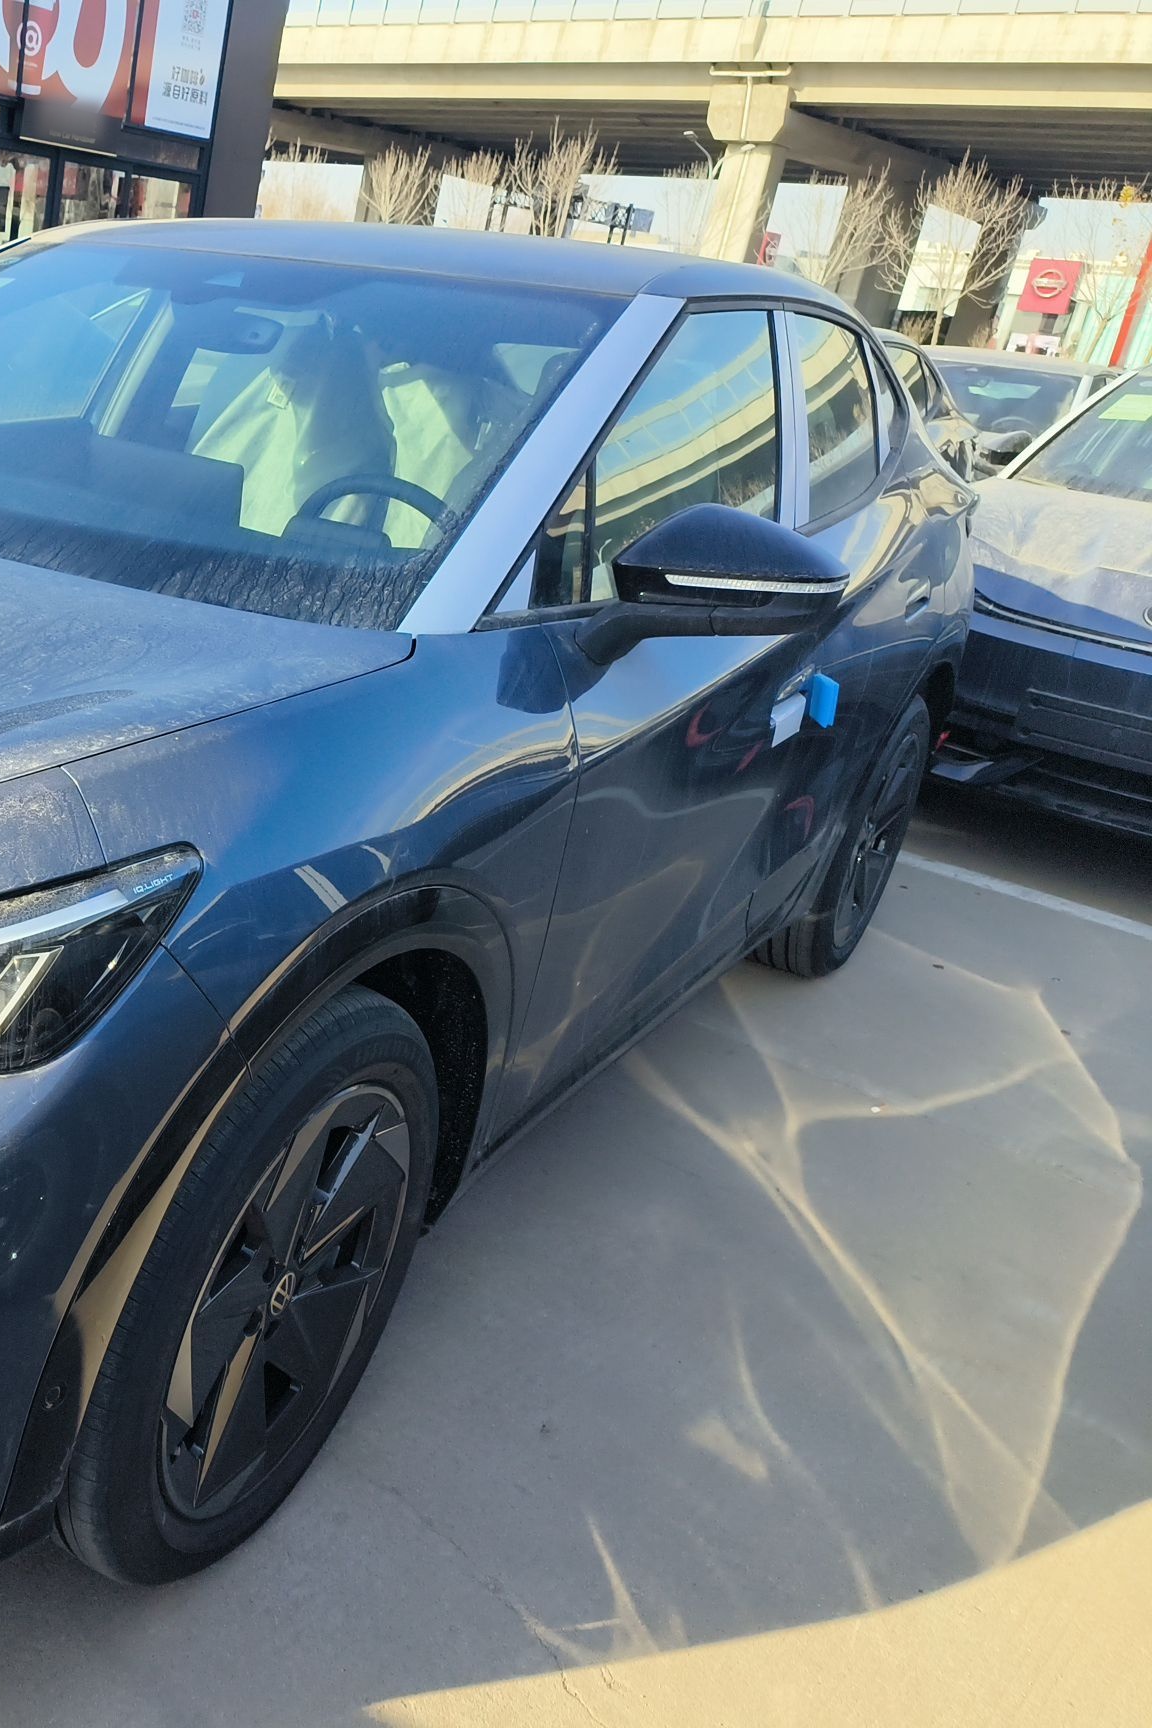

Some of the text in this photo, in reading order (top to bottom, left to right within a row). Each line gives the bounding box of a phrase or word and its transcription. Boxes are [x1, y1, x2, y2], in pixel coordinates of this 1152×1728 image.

[162, 81, 208, 106] 源自好原料
[133, 873, 173, 894] IQ.LIGHT
